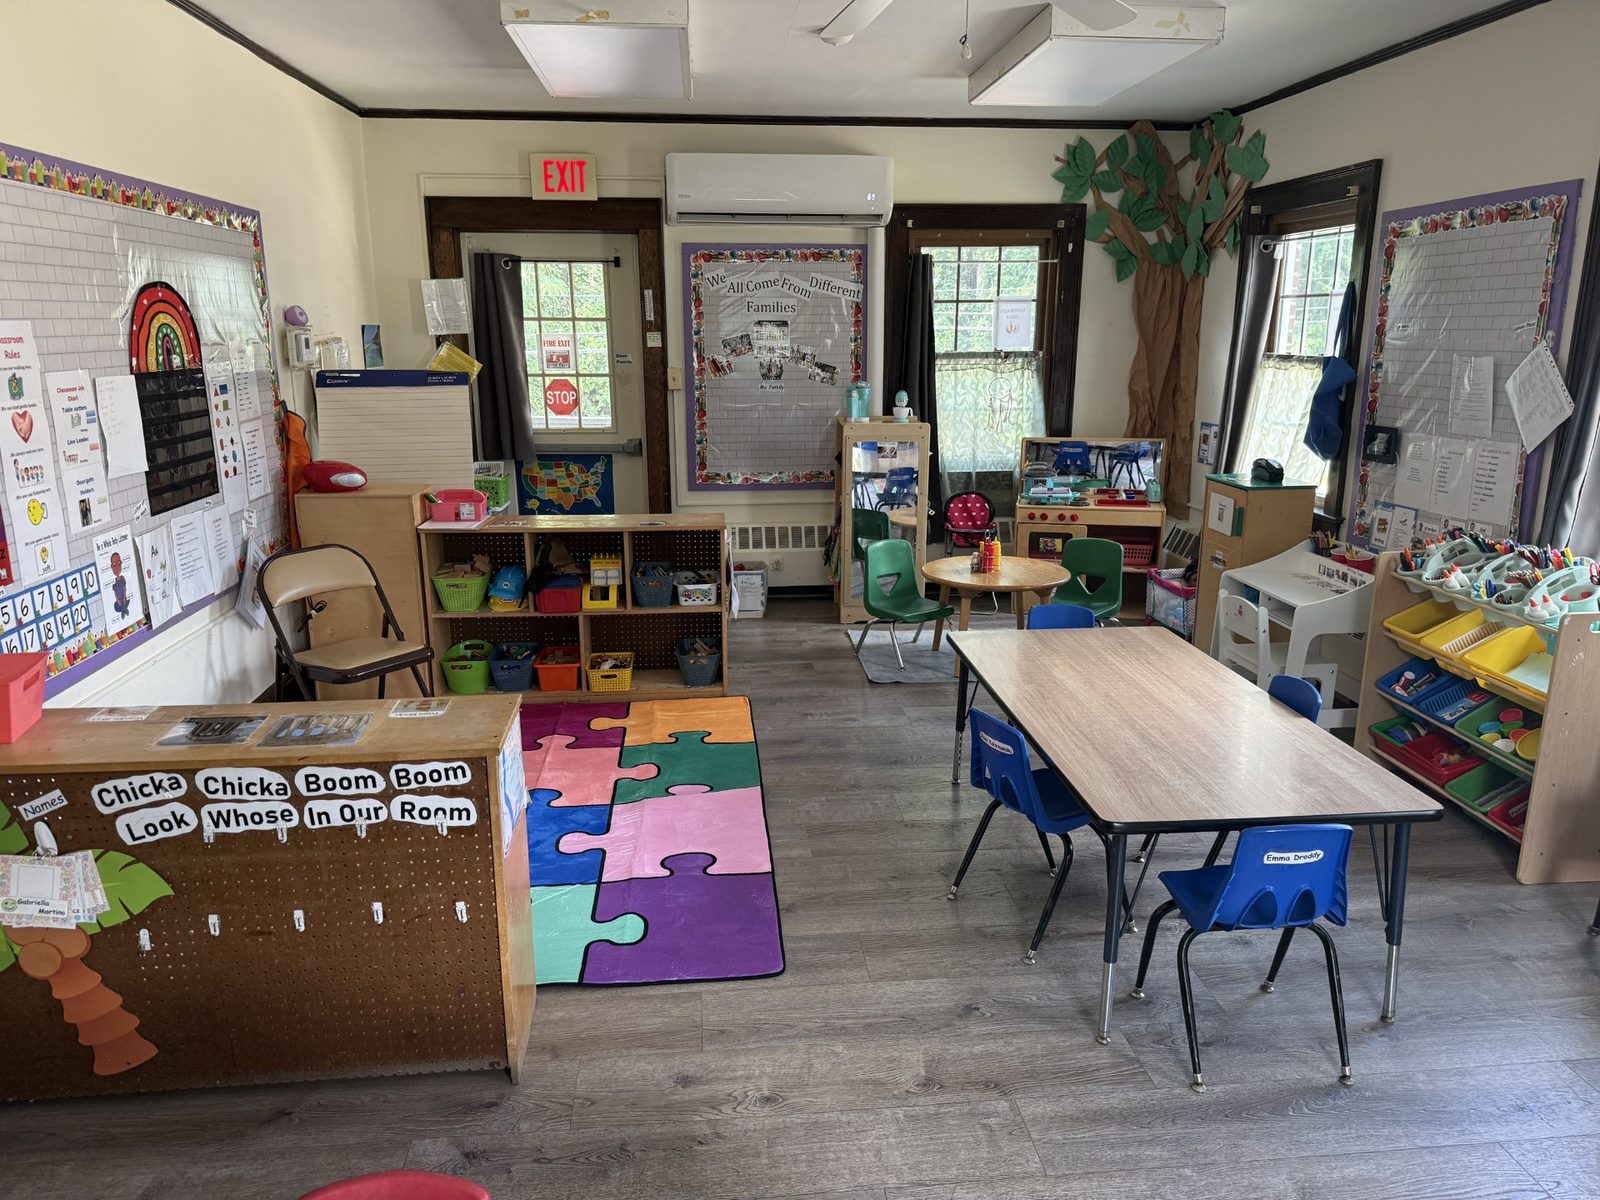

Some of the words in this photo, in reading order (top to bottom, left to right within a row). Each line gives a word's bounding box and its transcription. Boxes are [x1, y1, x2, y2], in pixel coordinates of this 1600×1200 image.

[543, 160, 586, 192] EXIT
[706, 274, 727, 287] We
[728, 282, 744, 294] All
[746, 278, 780, 292] Come
[780, 278, 812, 298] From
[810, 276, 862, 298] Different
[746, 301, 796, 312] Families
[546, 391, 576, 404] STOP
[0, 605, 10, 624] 5
[21, 598, 28, 616] 6
[38, 591, 44, 609] 7
[56, 584, 63, 602] 8
[71, 577, 79, 594] 9
[85, 571, 94, 590] 10
[6, 639, 18, 653] 16
[24, 629, 34, 650] 17
[43, 622, 54, 641] 18
[60, 614, 70, 633] 19
[74, 605, 87, 626] 20
[98, 775, 182, 807] Chicka
[203, 776, 288, 796] Chicka
[304, 773, 377, 793] Boom
[394, 764, 467, 788] Boom
[23, 794, 64, 818] Names
[126, 810, 190, 842] Look
[208, 807, 293, 829] Whose
[308, 807, 331, 826] In
[339, 804, 383, 822] Our
[400, 801, 470, 821] Room
